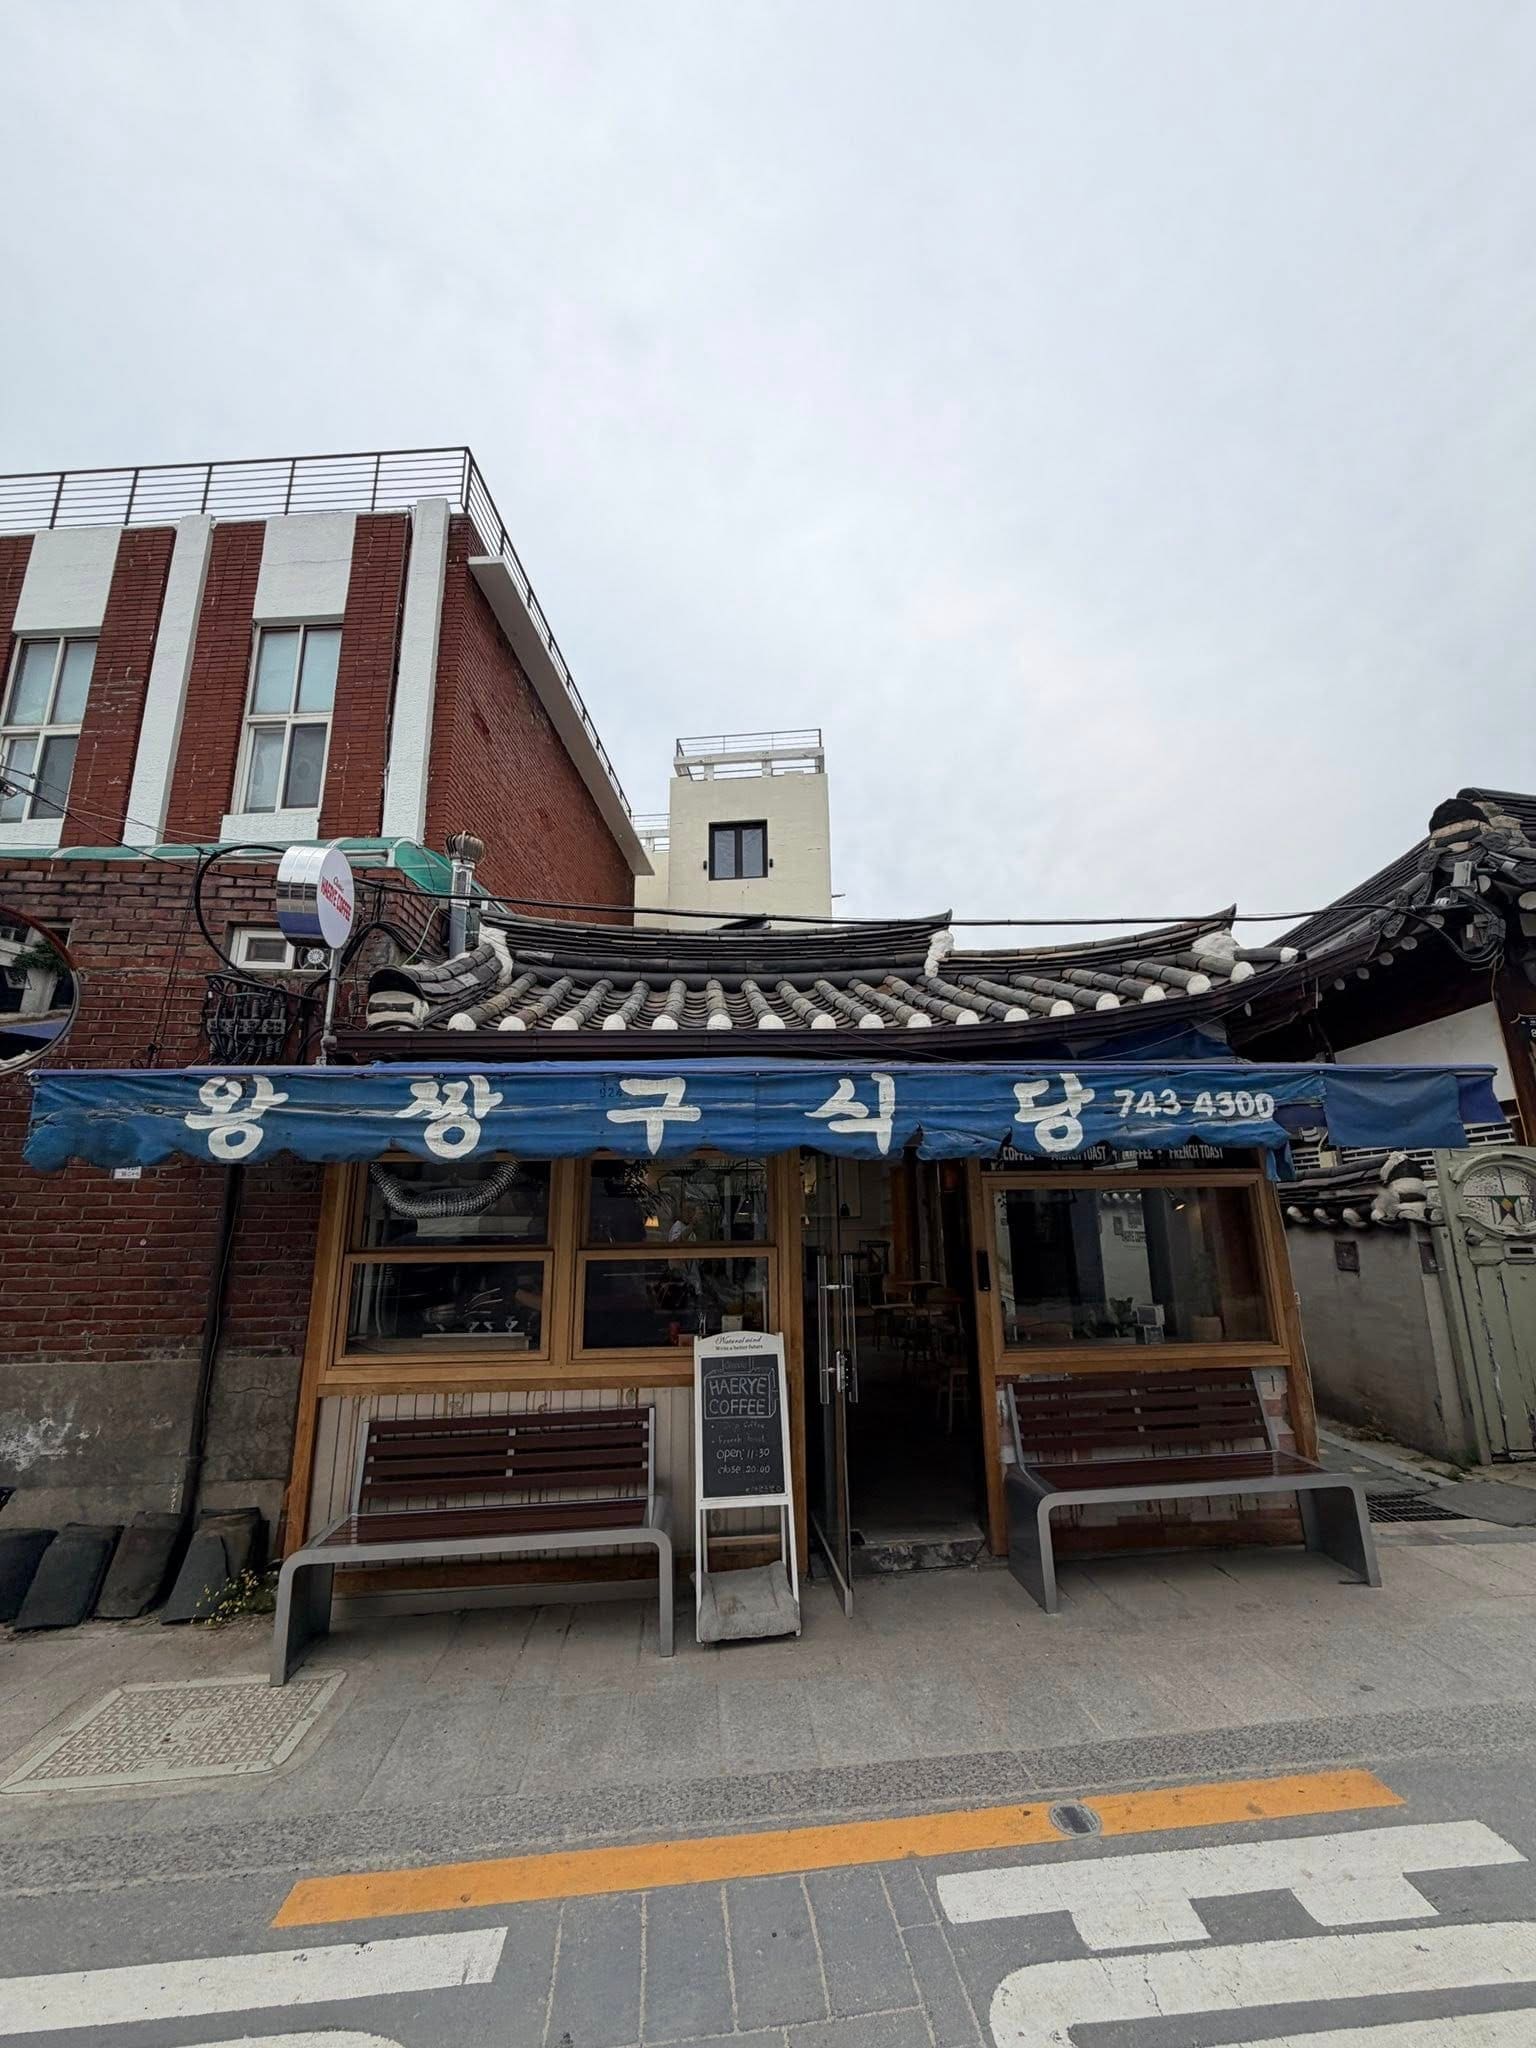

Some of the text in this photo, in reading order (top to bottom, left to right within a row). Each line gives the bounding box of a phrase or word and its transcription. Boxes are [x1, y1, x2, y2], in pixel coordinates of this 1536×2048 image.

[337, 895, 352, 922] COFFEE
[1114, 1088, 1182, 1118] 743
[1192, 1090, 1275, 1119] 4300
[709, 1377, 768, 1396] HAERYE
[709, 1398, 766, 1415] COFFEE
